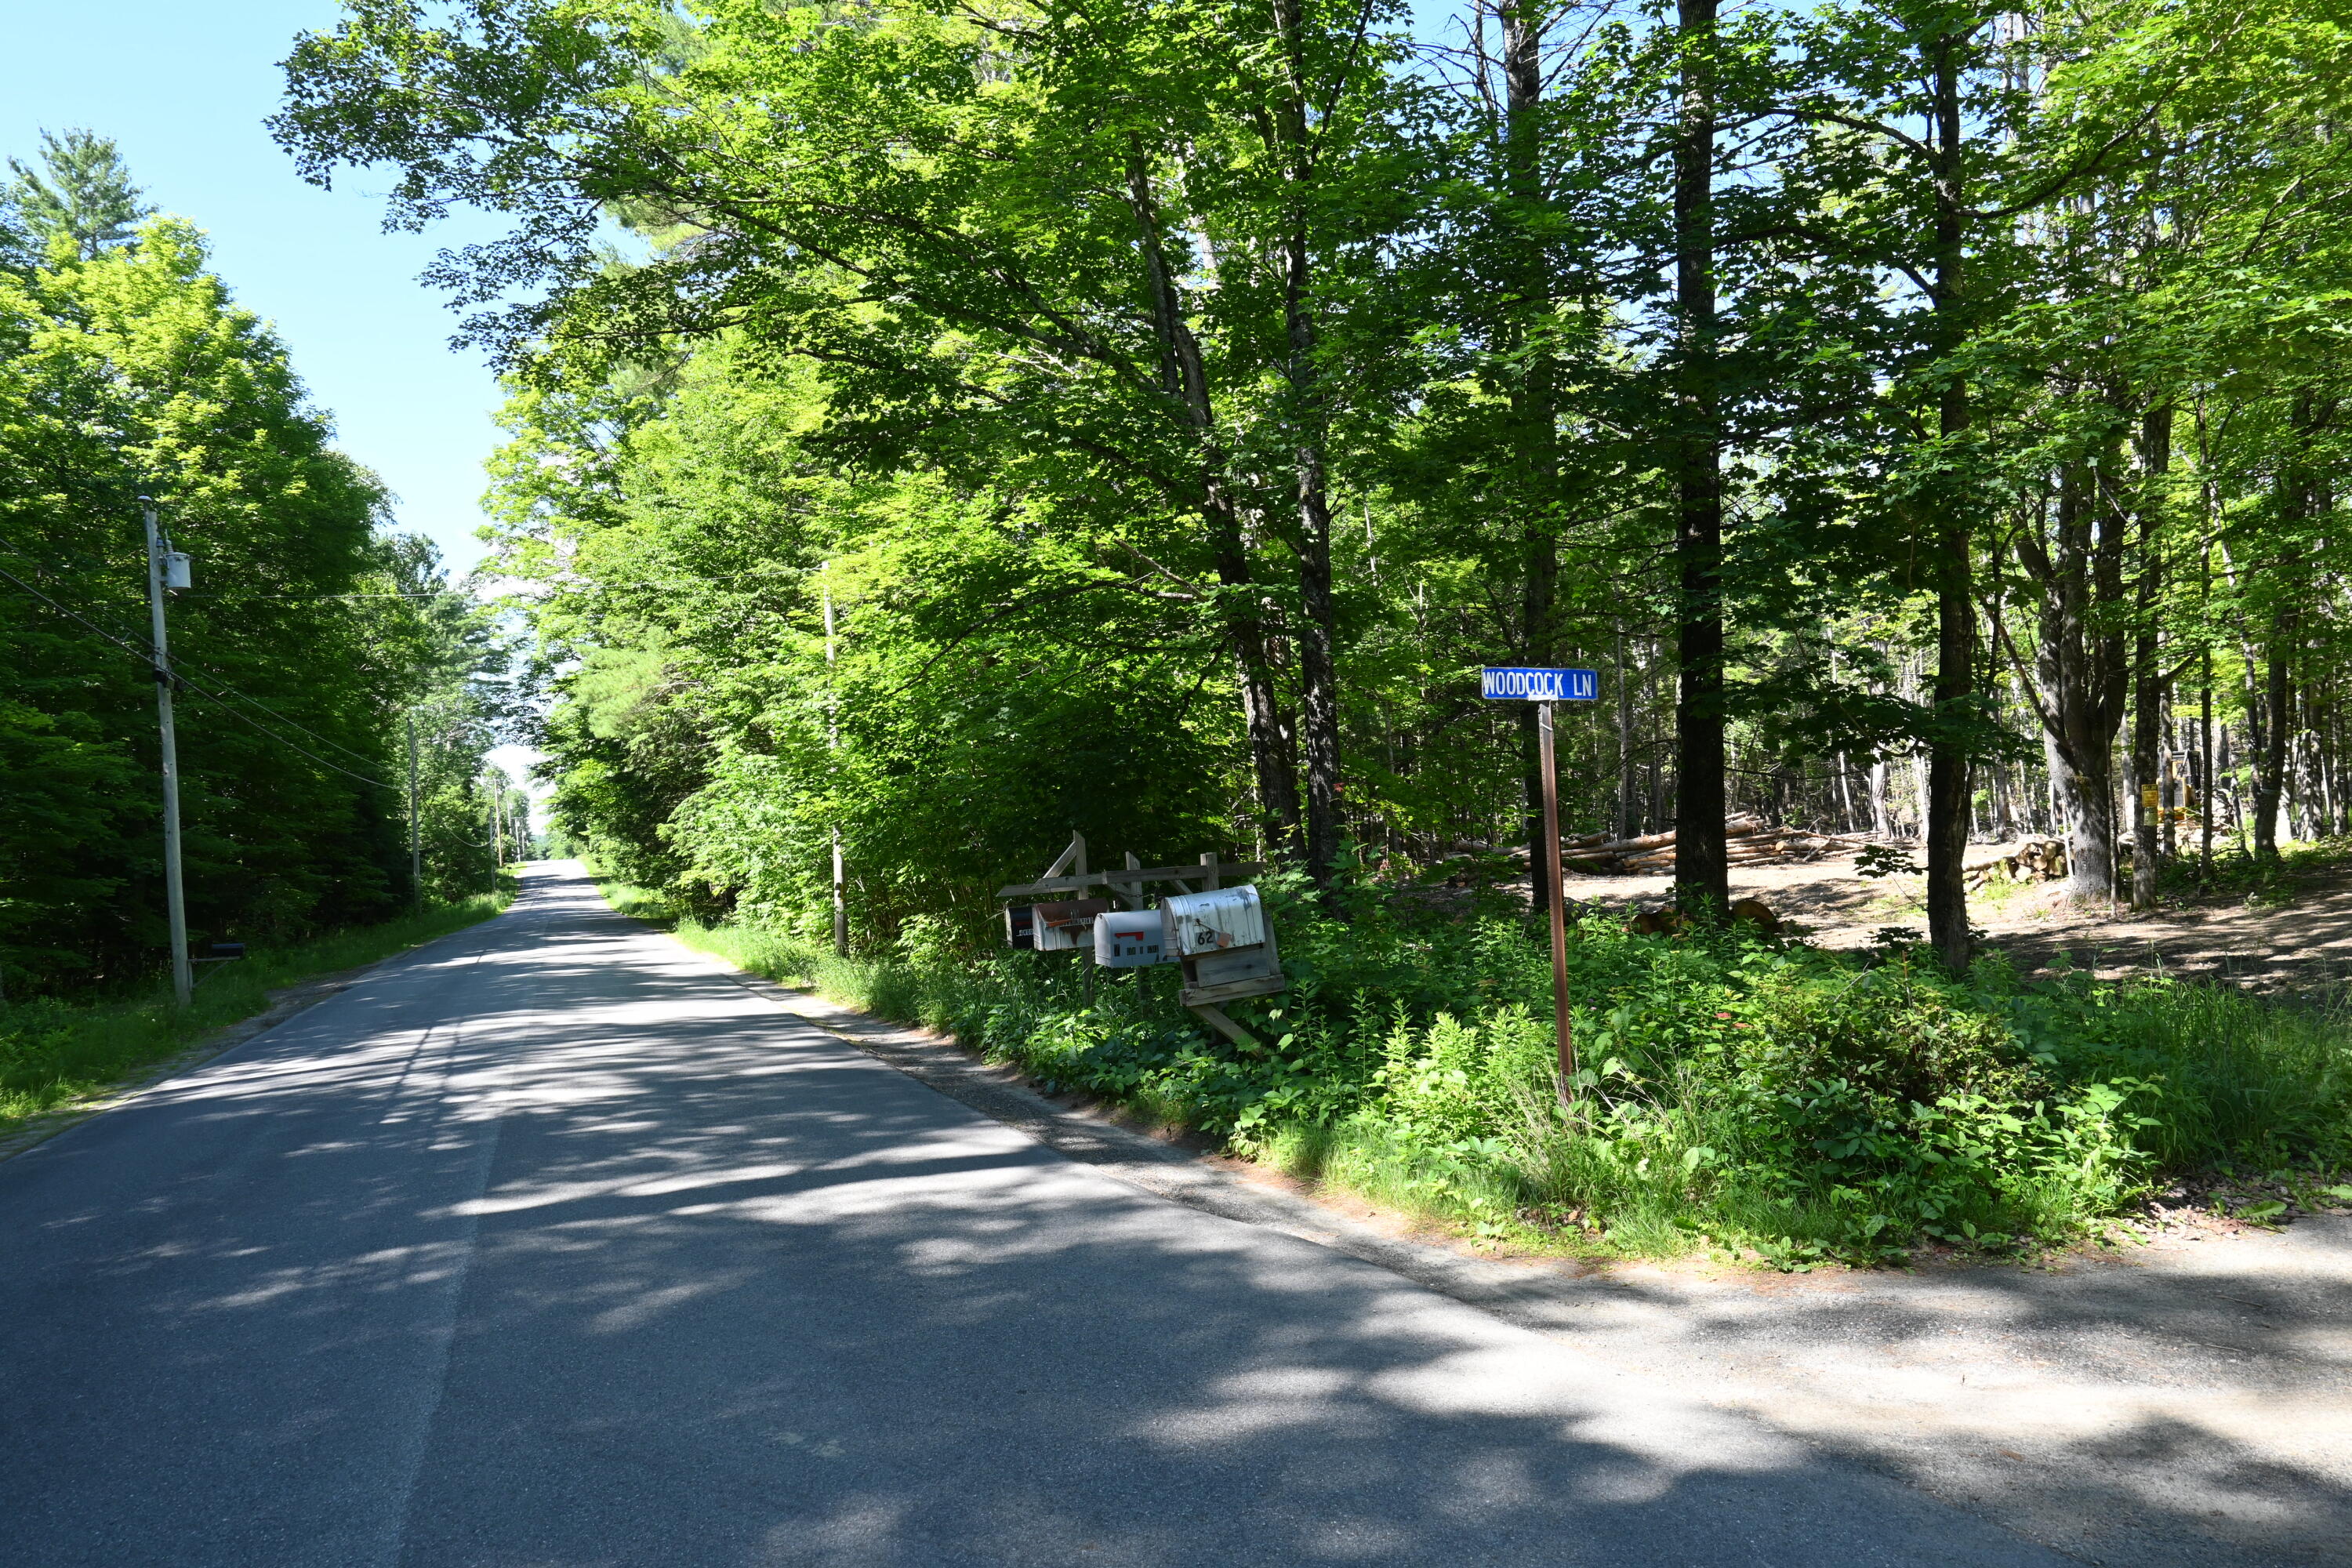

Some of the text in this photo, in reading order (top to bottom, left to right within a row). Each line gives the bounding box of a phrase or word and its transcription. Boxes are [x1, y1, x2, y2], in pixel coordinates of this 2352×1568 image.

[1483, 671, 1592, 696] WOODCOCK LN
[1197, 931, 1214, 945] 62
